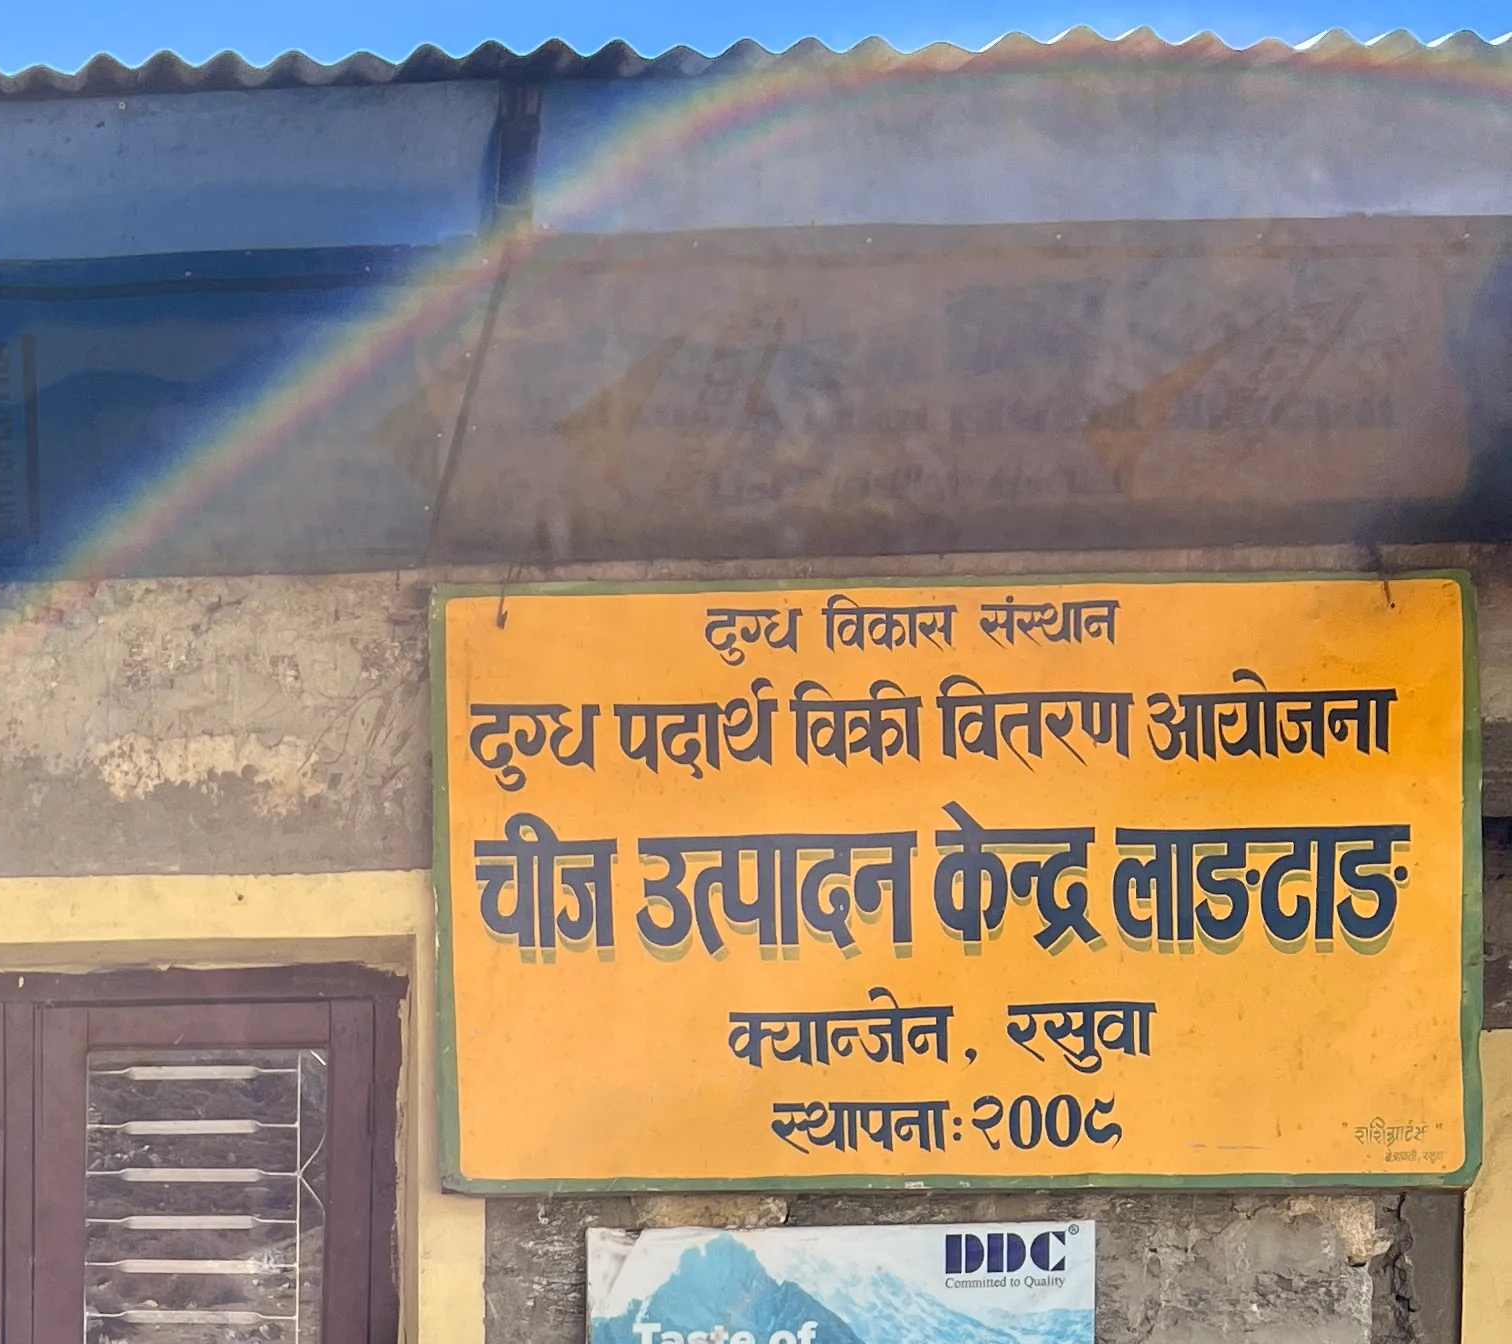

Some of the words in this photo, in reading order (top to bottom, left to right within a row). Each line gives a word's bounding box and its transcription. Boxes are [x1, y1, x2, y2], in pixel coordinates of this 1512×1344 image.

[704, 608, 803, 665] दुग्ध
[823, 594, 957, 651] विकास
[980, 596, 1119, 649] संस्थान
[469, 704, 601, 792] दुग्ध
[614, 677, 779, 779] पदार्थ
[936, 674, 1133, 772] वितरण
[1146, 668, 1397, 762] आयोजना
[474, 812, 618, 950] चीज
[636, 830, 918, 957] उत्पादन
[933, 801, 1102, 951] केन्द्र
[1006, 1002, 1158, 1075] रसुवा
[945, 1276, 1007, 1289] Committed
[1010, 1277, 1021, 1288] to
[1024, 1275, 1066, 1288] Quality
